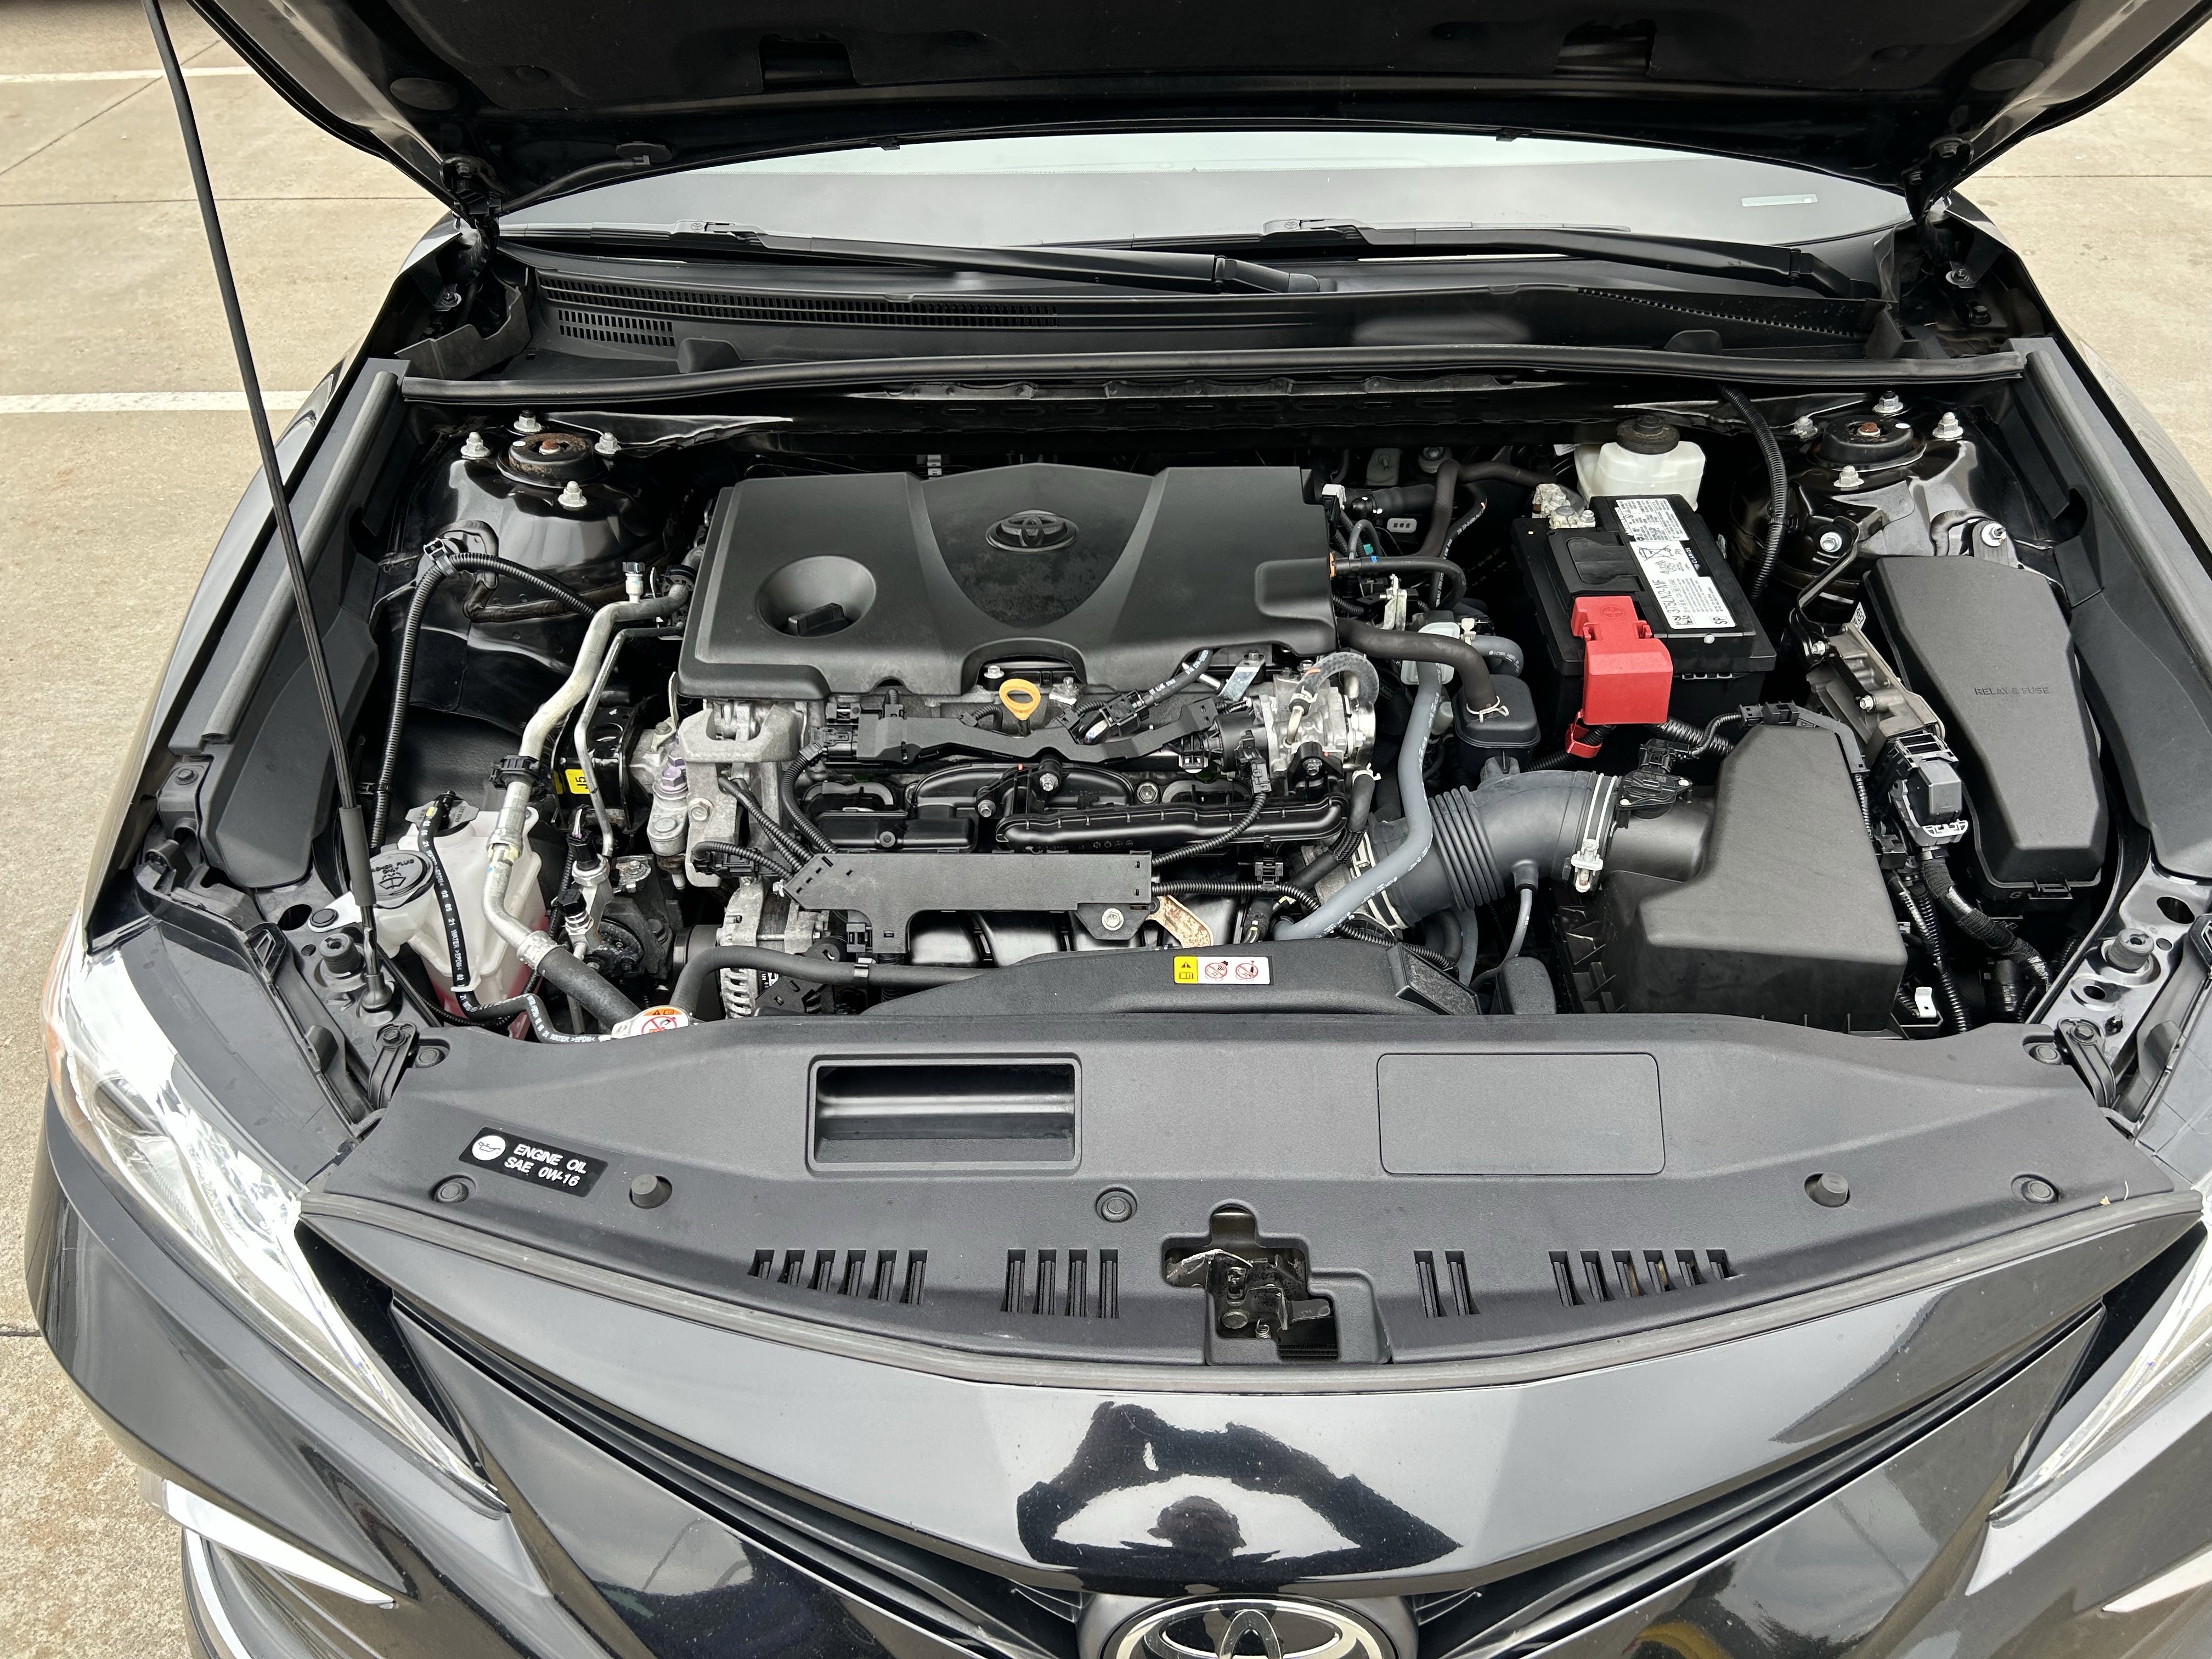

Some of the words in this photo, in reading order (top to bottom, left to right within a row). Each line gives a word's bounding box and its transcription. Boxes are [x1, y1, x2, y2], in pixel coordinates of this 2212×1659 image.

[1652, 579, 1680, 613] 375LN2-MF
[1975, 687, 2009, 695] RELAY
[444, 903, 453, 912] 05
[448, 918, 456, 926] 21
[450, 929, 460, 949] WATER
[514, 1144, 563, 1166] ENGINE
[566, 1159, 587, 1174] OIL
[504, 1157, 534, 1173] SAE
[538, 1167, 580, 1187] 0W-16
